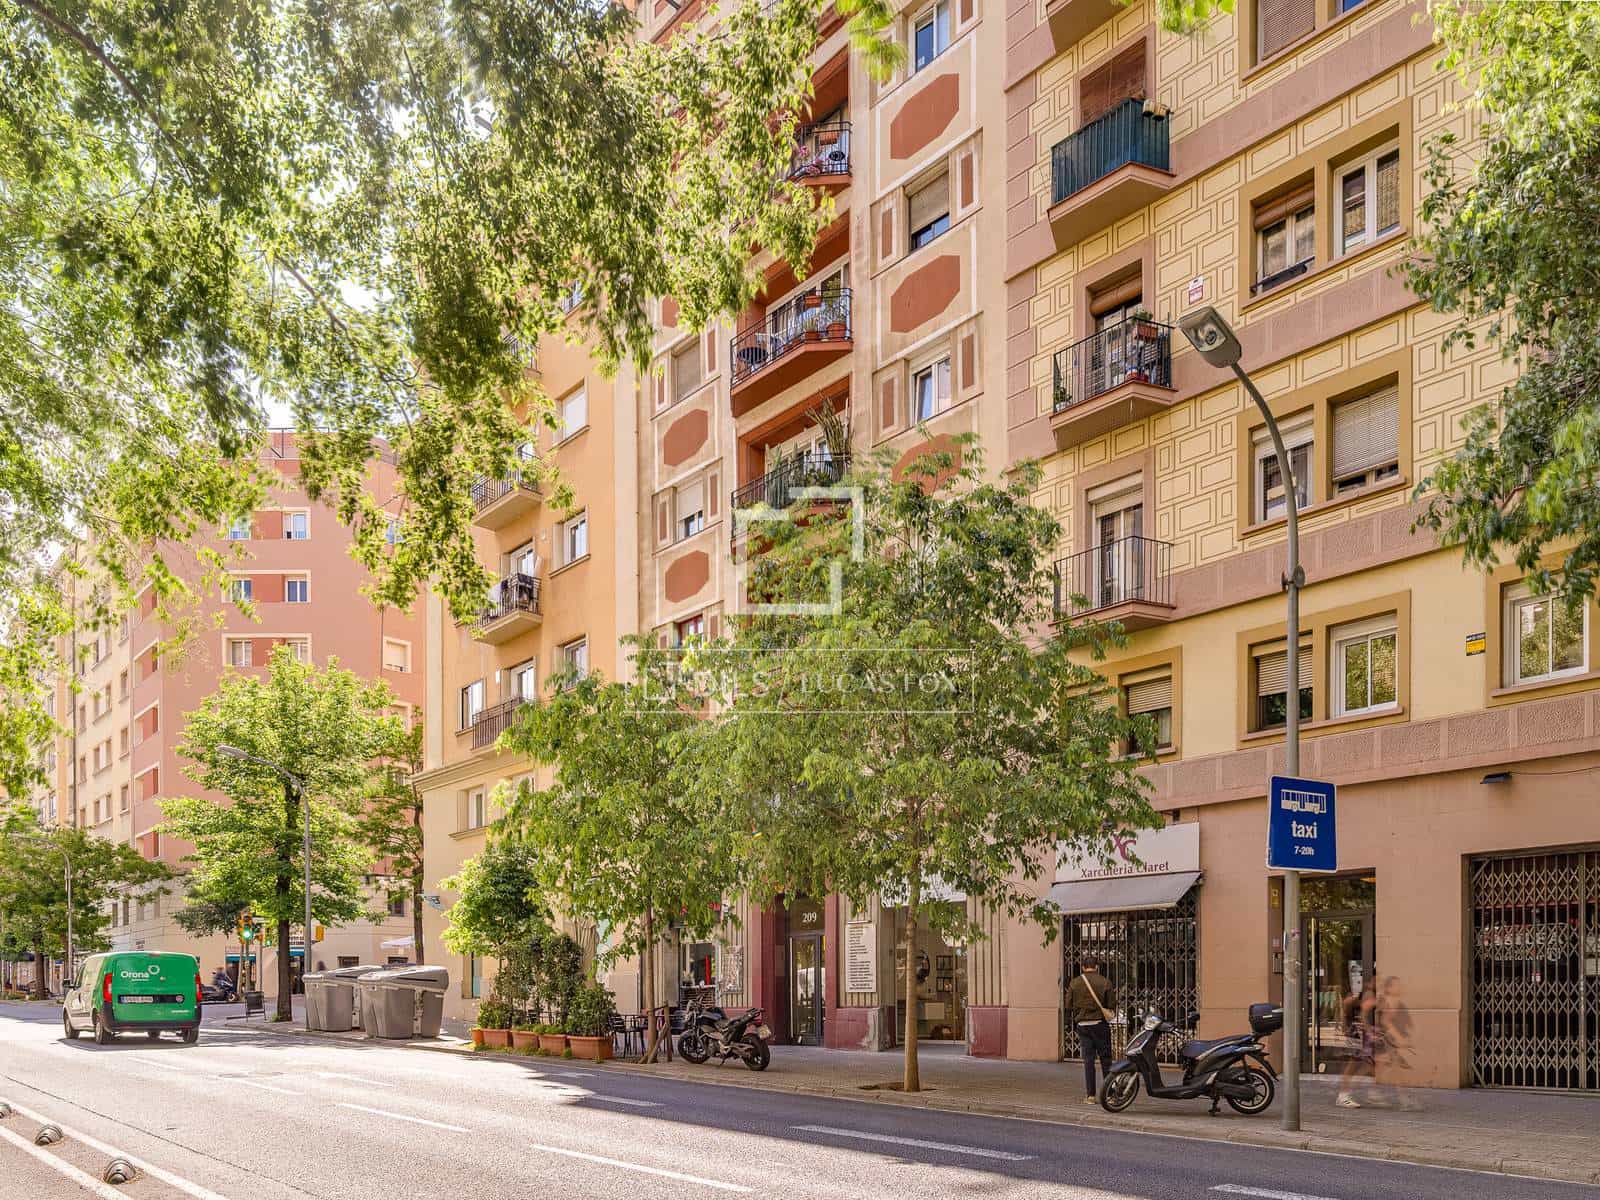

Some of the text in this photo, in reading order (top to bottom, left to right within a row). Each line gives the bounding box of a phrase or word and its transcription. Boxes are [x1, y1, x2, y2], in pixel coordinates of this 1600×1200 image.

[1291, 820, 1317, 838] taxi
[1294, 845, 1315, 856] 7-20h
[802, 911, 817, 923] 209
[120, 970, 150, 979] Orona
